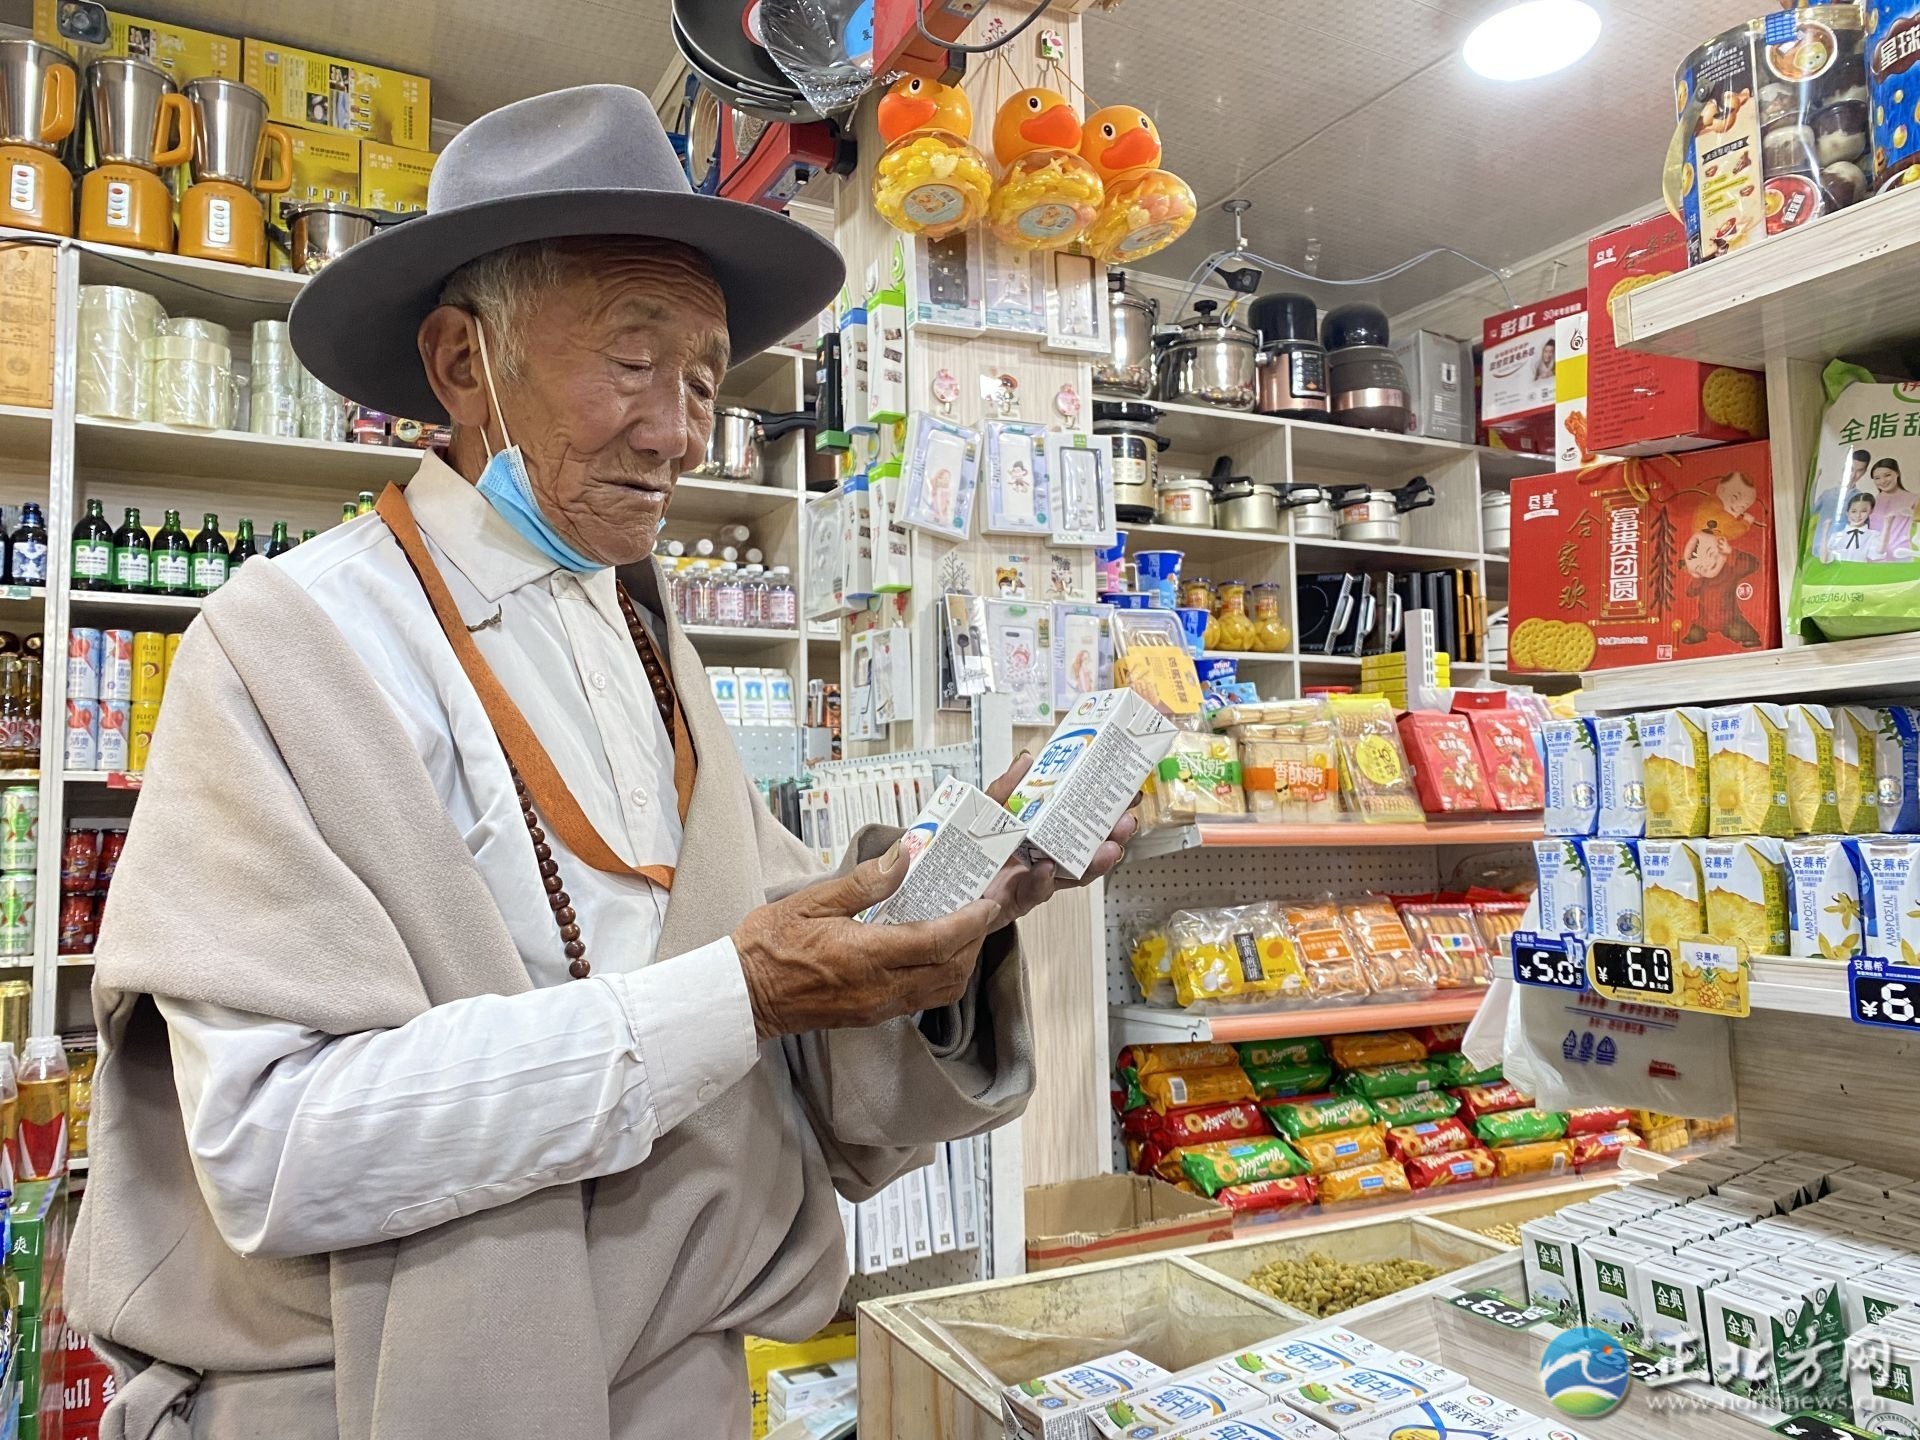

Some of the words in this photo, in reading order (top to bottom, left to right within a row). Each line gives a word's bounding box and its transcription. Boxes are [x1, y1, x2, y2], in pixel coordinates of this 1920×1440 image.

[1500, 312, 1536, 338] 彩虹
[1558, 507, 1603, 611] 合家欢
[1609, 506, 1640, 603] 富贵团圆
[1640, 724, 1665, 738] 安慕希
[1711, 718, 1740, 733] 安慕希
[1588, 854, 1616, 866] 安慕希
[1643, 854, 1670, 867] 安慕希
[1704, 857, 1733, 869] 安慕希
[1792, 856, 1827, 869] 安慕希
[1870, 858, 1910, 871] 安慕希
[1695, 951, 1721, 962] 安慕希
[1853, 960, 1884, 972] 安慕希
[1539, 1242, 1562, 1268] 金典
[1599, 1263, 1624, 1290] 金典
[1656, 1285, 1683, 1312] 金典
[1726, 1312, 1756, 1341] 金典
[1276, 1343, 1341, 1372] 纯牛奶
[1062, 1370, 1120, 1398] 纯牛奶
[1342, 1371, 1412, 1401] 纯牛奶
[1150, 1388, 1211, 1420] 纯牛奶
